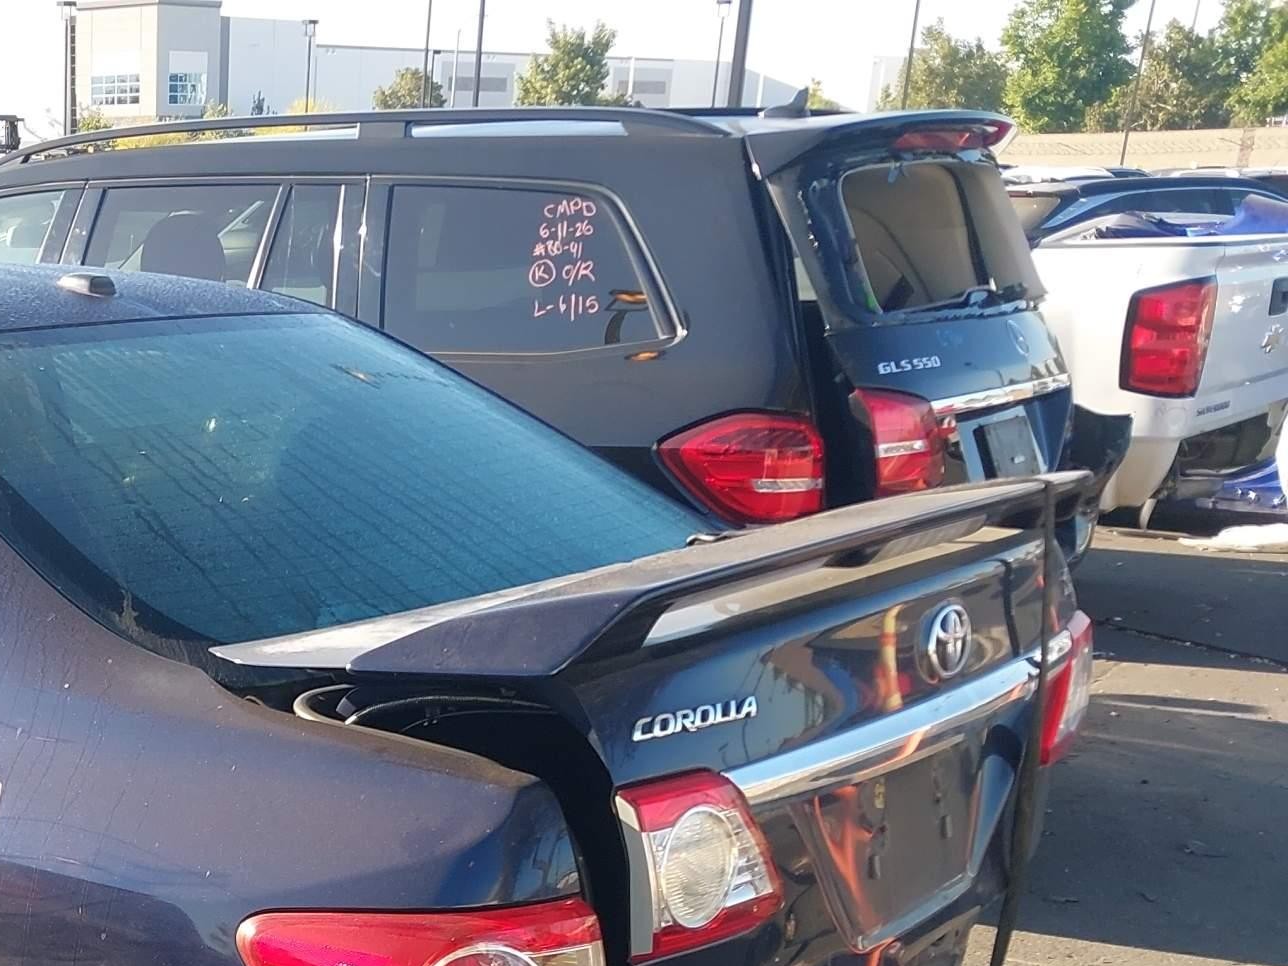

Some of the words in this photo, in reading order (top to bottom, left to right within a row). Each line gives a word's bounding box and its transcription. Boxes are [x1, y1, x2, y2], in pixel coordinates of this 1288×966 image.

[543, 198, 597, 218] CMPD
[539, 220, 594, 241] 6-11-26
[877, 359, 912, 375] GLS
[912, 355, 942, 370] 550
[632, 695, 758, 742] COROLLA
